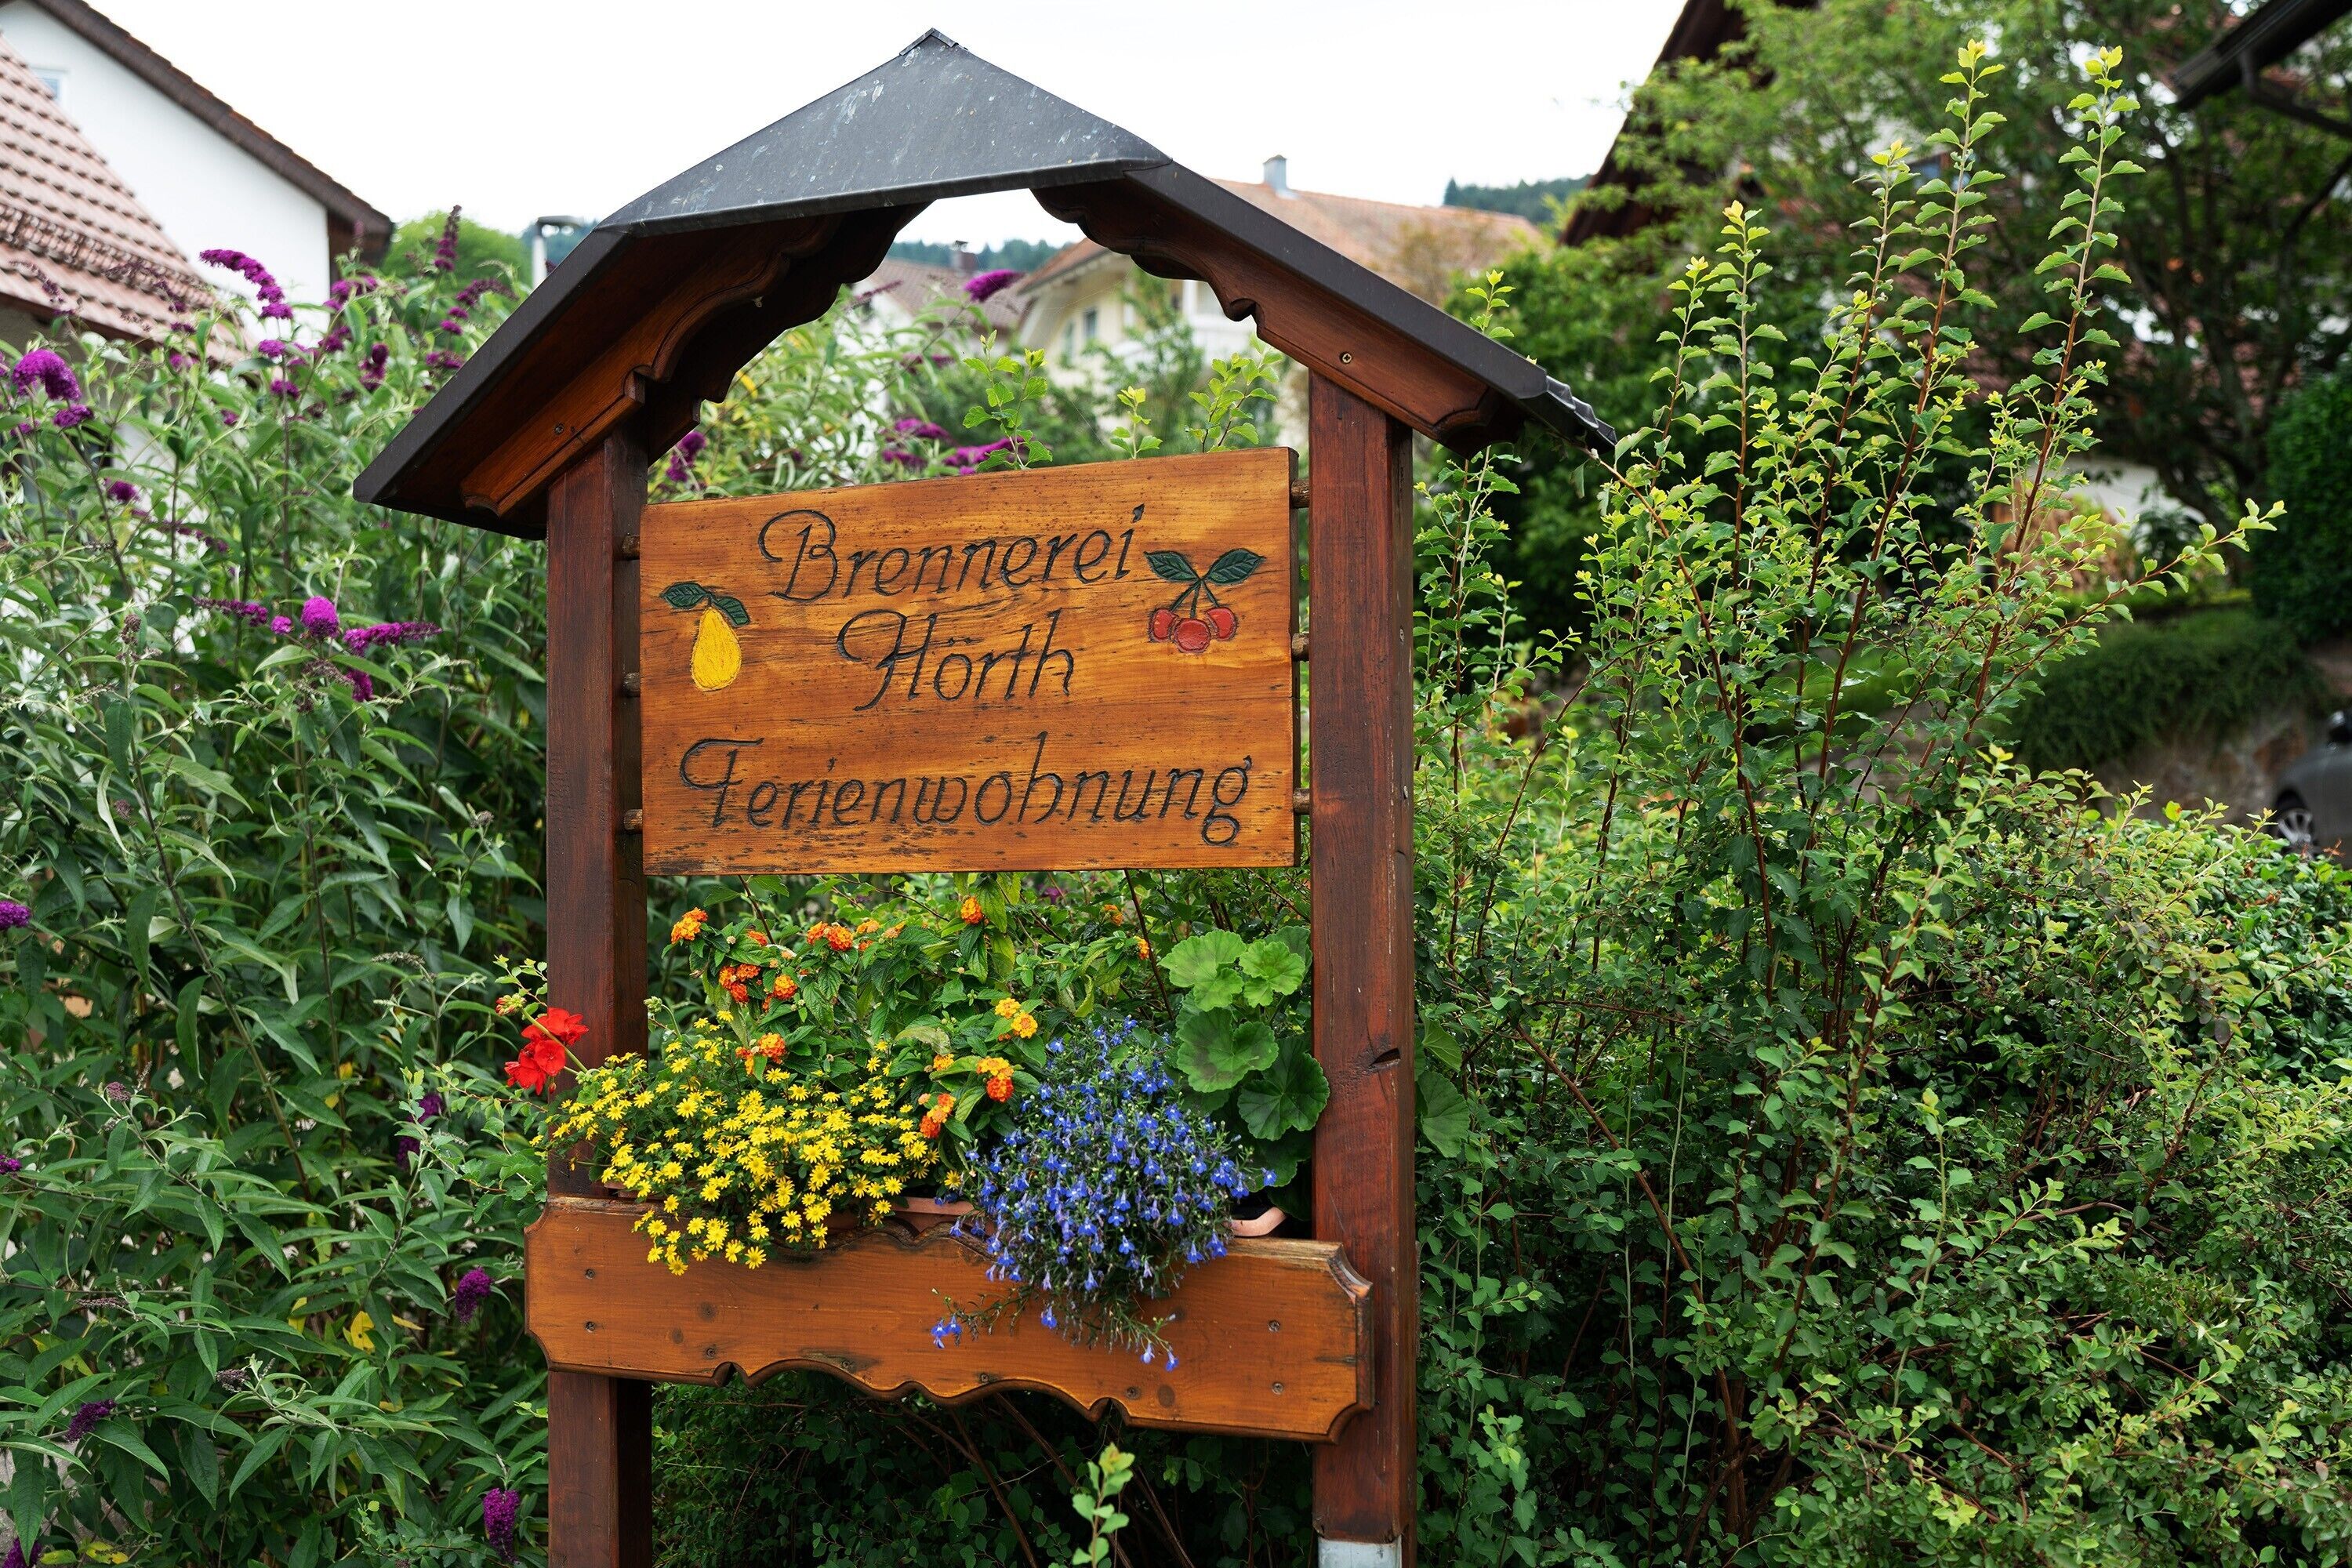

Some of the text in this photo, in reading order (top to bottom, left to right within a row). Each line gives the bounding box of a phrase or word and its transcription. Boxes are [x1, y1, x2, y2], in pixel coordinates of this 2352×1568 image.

[757, 503, 1145, 603] Brennerei
[836, 608, 1075, 711] Hörth
[679, 731, 1252, 846] Ferienwohnung
